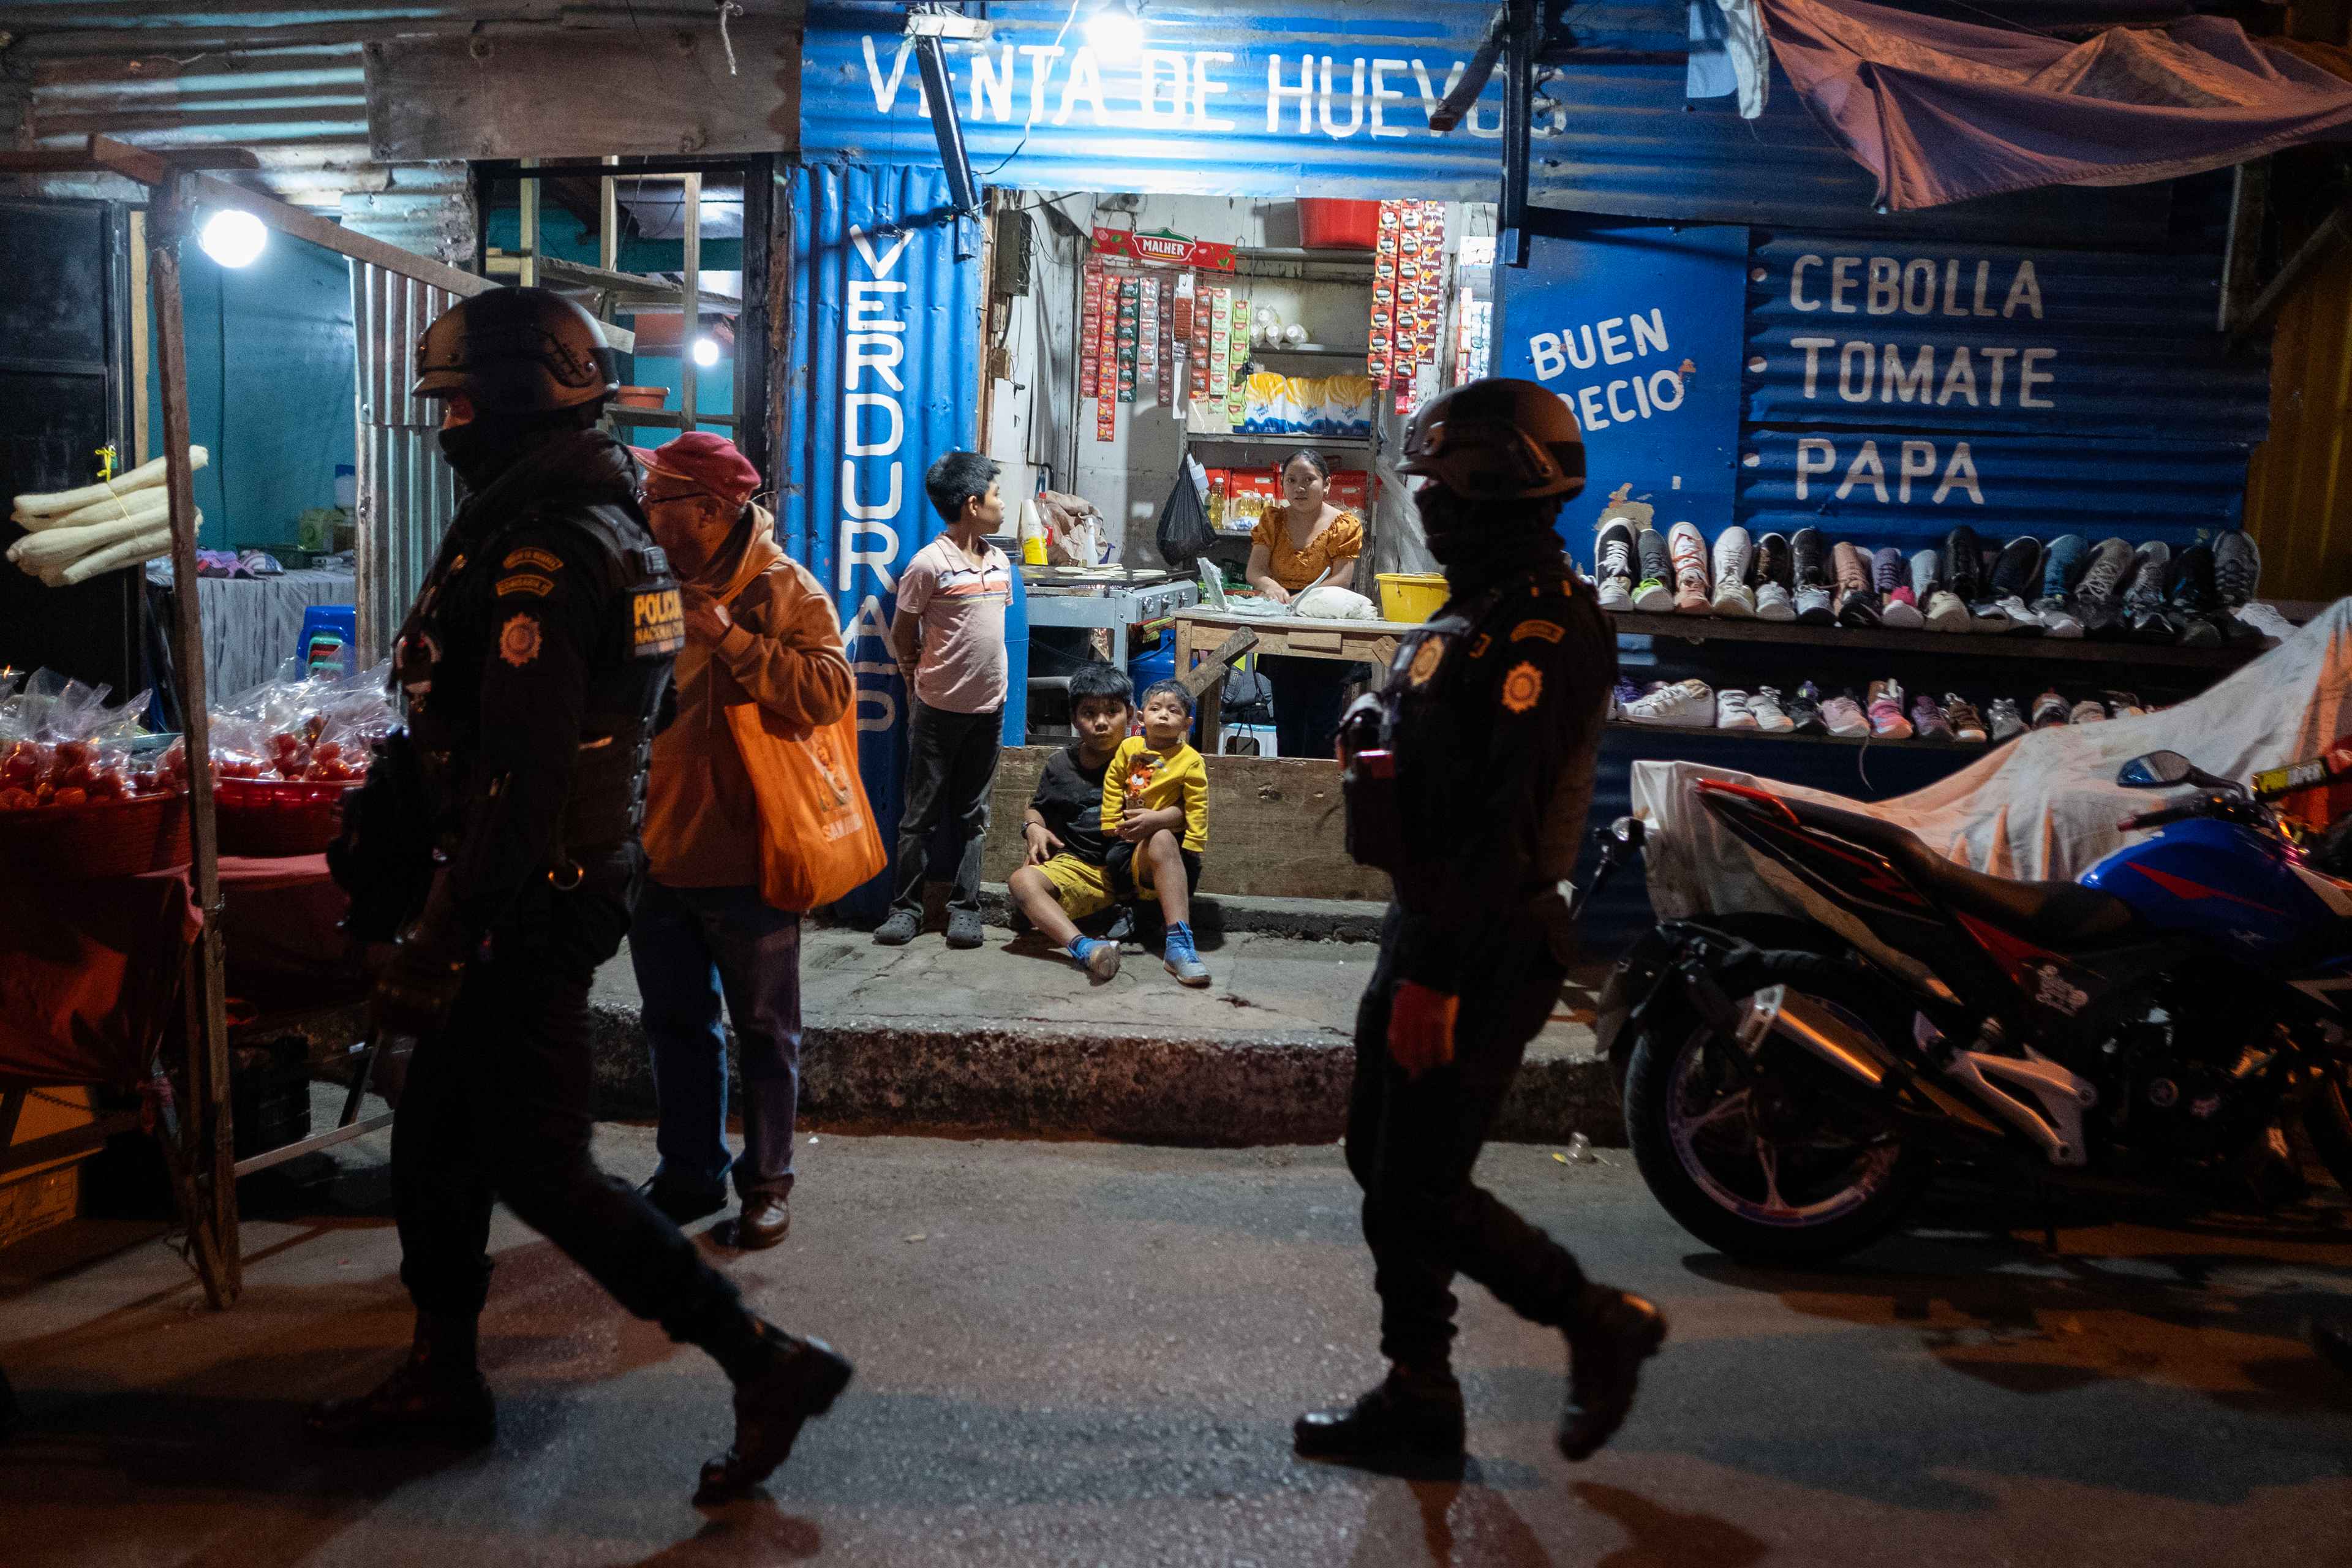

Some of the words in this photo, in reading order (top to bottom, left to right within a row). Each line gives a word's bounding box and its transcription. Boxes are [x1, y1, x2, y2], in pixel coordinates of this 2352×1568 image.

[1140, 49, 1235, 131] DE
[1142, 239, 1184, 257] MALHER
[1790, 254, 2043, 319] CEBOLLA
[1529, 308, 1669, 381] BUEN
[1790, 337, 2057, 408] TOMATE
[1557, 369, 1685, 432] ECIO
[1796, 438, 1985, 505] PAPA
